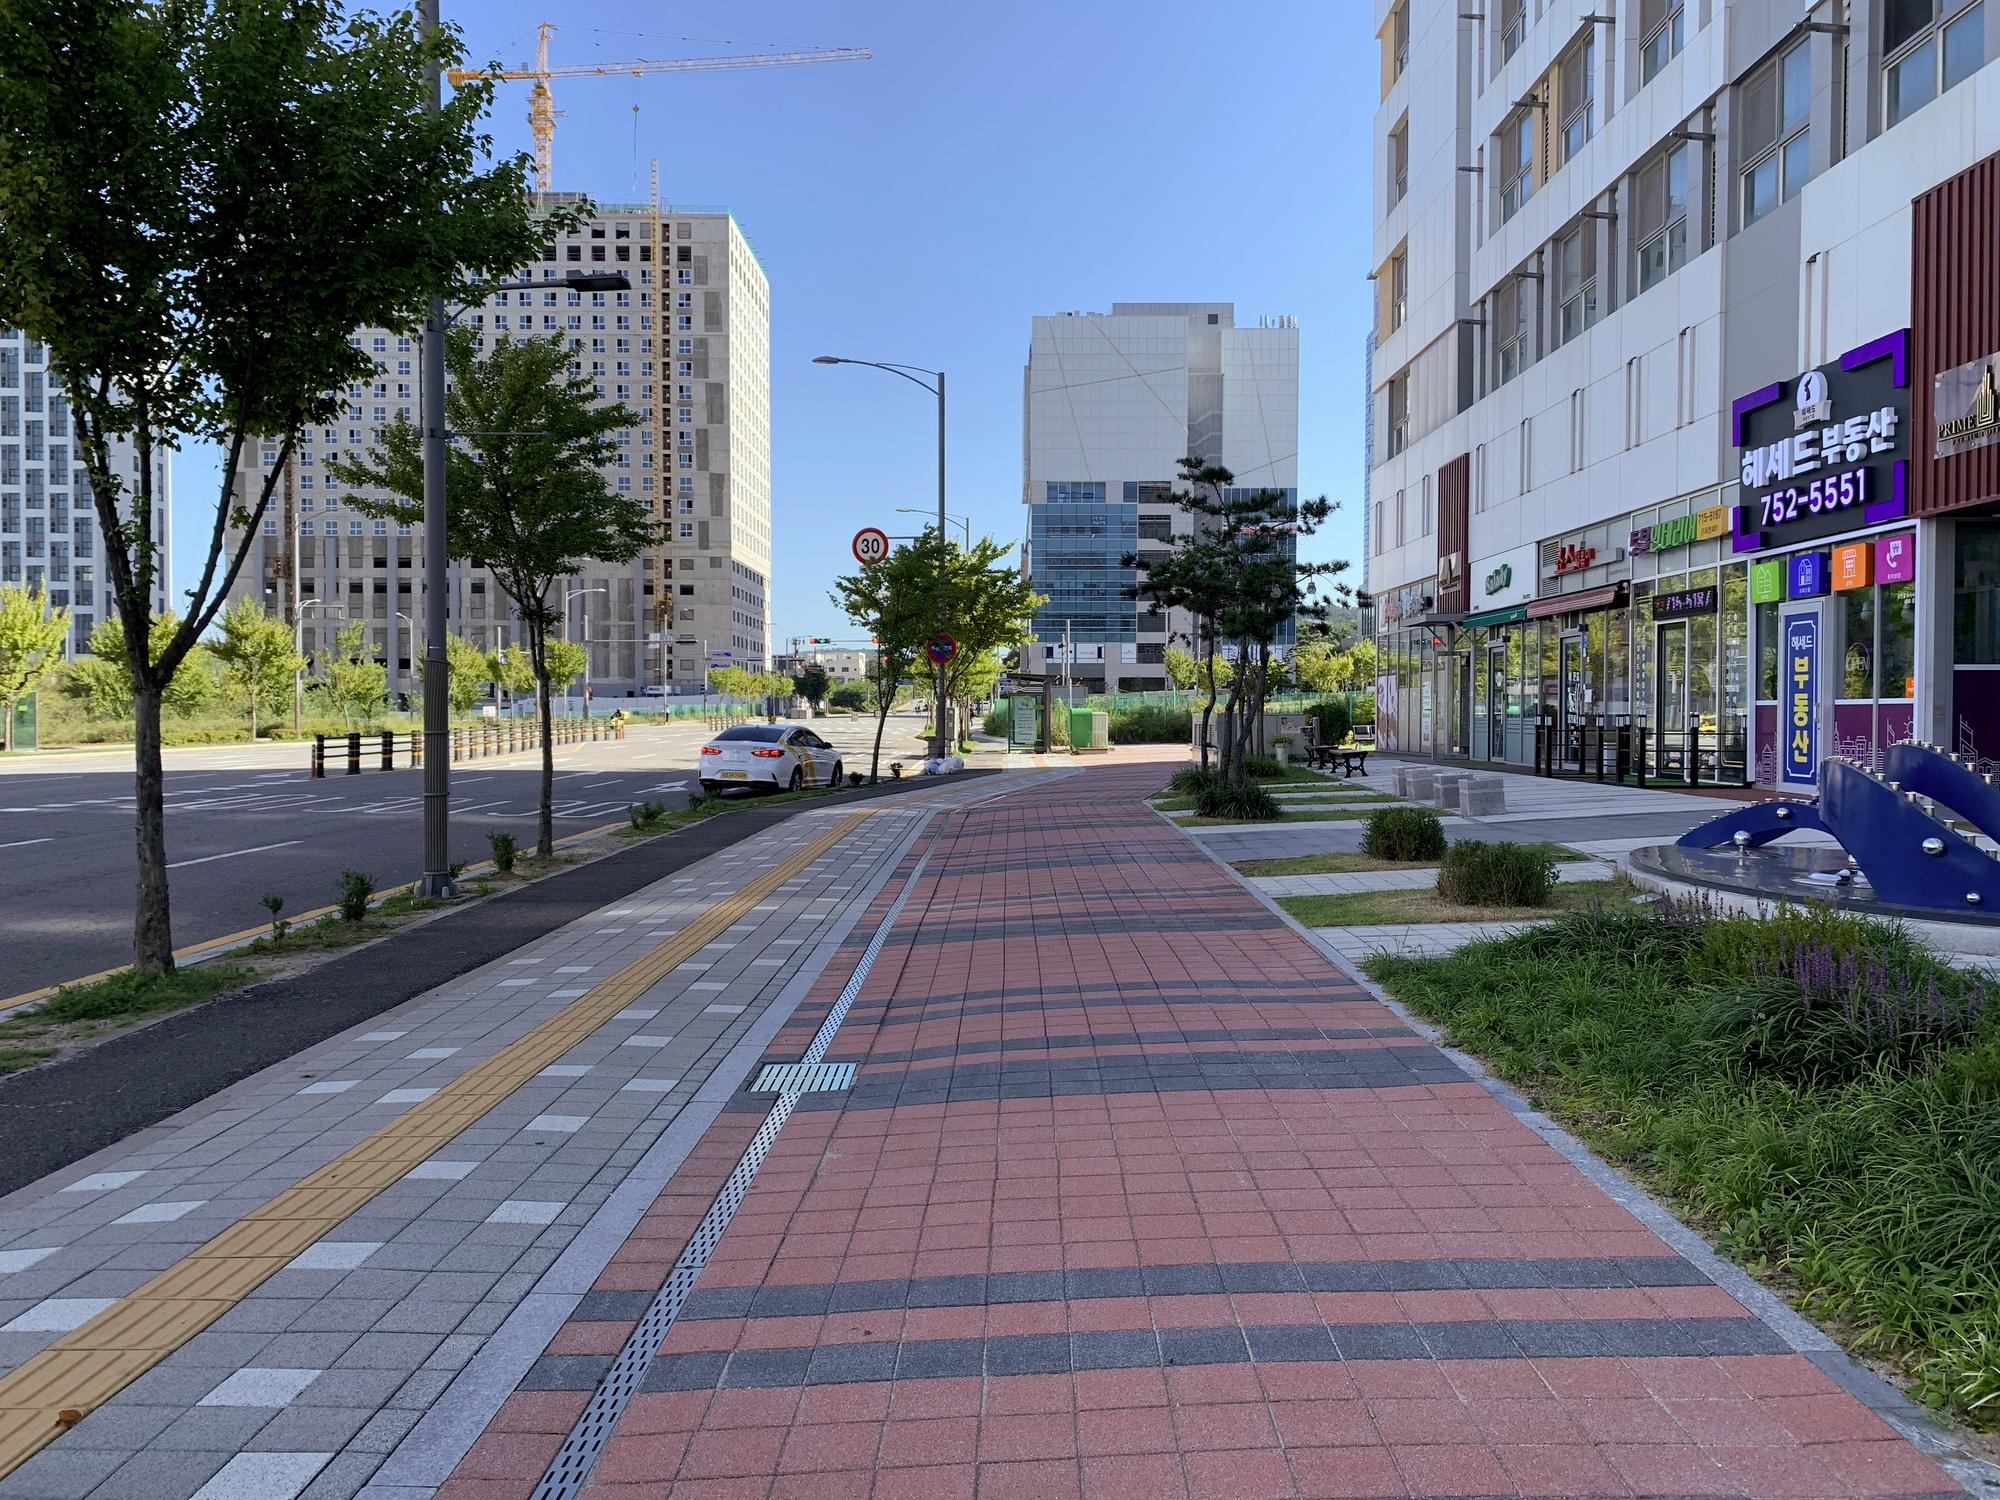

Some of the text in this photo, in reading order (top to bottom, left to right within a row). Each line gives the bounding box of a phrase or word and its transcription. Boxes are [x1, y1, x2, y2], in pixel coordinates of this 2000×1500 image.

[1936, 414, 1976, 438] PRIME
[1760, 468, 1866, 526] 752-5551
[861, 538, 880, 555] 30
[1791, 635, 1813, 650] 헤세드
[1846, 656, 1868, 671] OPEN
[1792, 656, 1810, 763] 부동산
